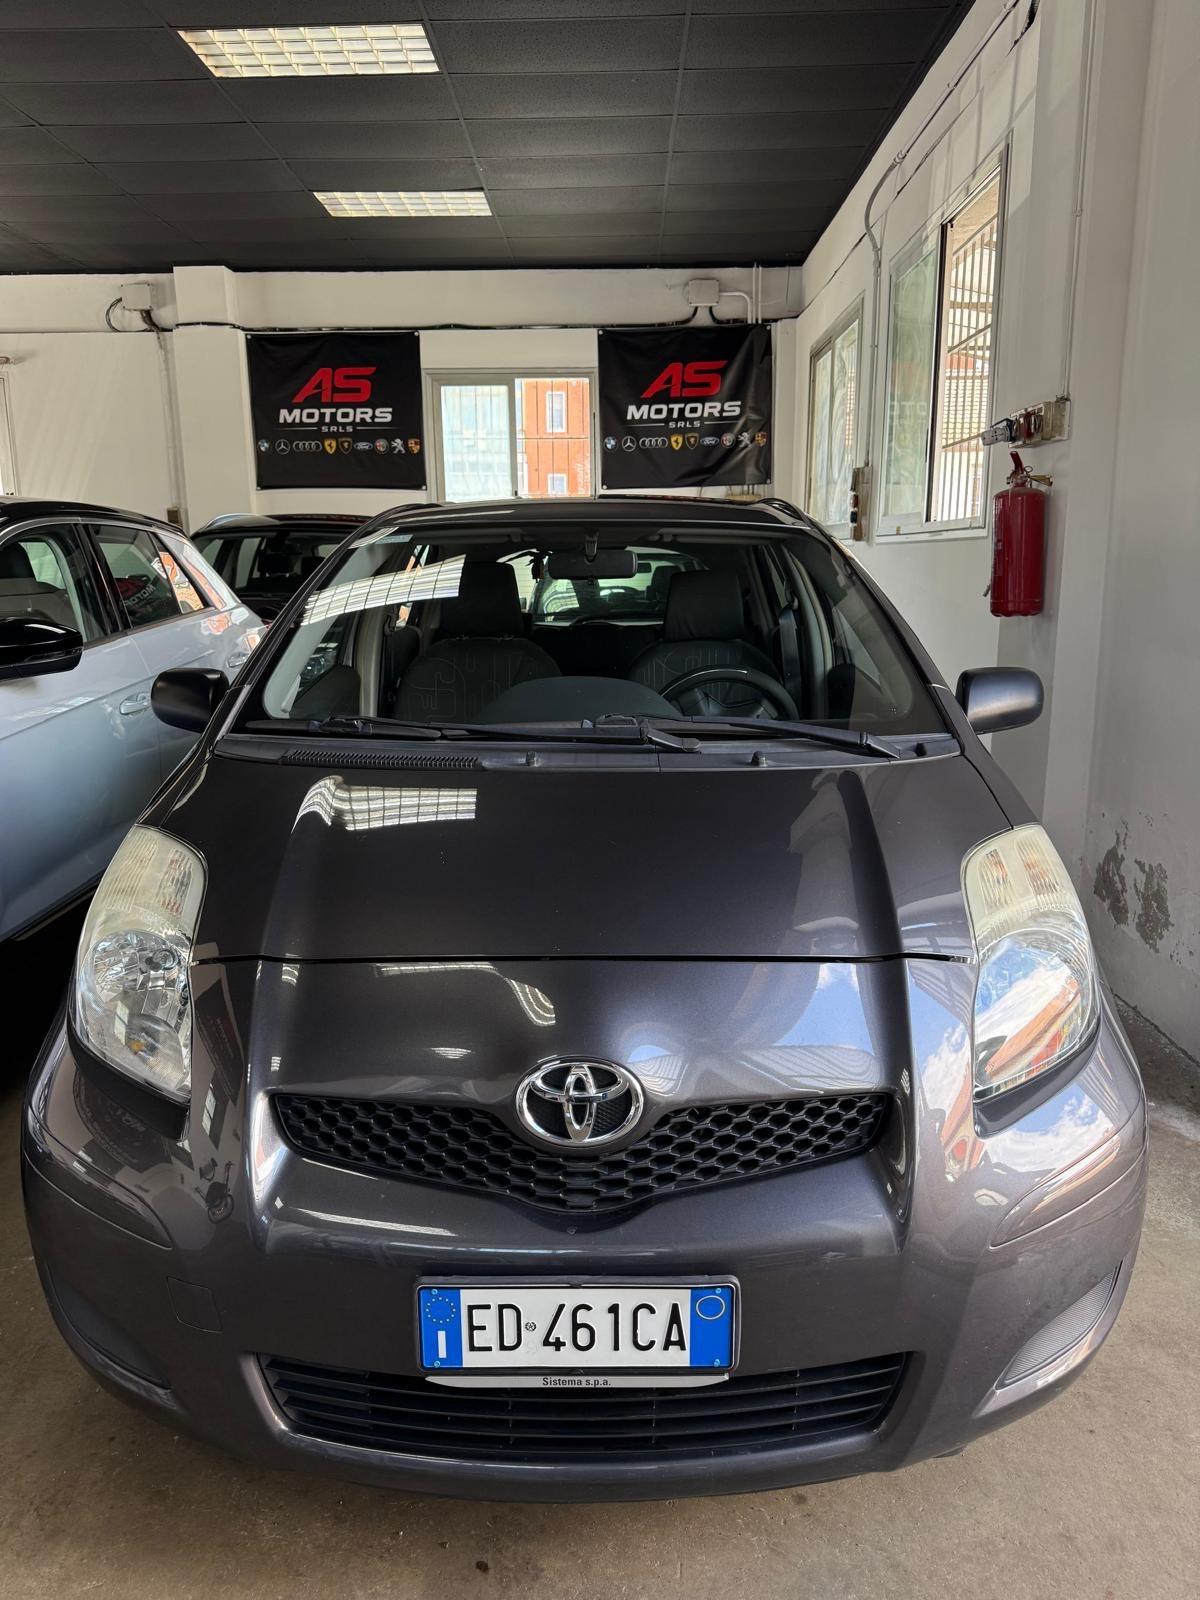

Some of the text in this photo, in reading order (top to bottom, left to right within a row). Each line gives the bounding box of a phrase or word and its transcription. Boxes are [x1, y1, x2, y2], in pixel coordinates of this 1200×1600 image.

[291, 367, 377, 403] AS
[640, 360, 728, 399] AS
[278, 407, 393, 423] MOTORS
[626, 401, 742, 420] MOTORS
[321, 425, 354, 433] SRLS
[668, 420, 701, 428] SRLS
[467, 1302, 687, 1352] ED 461CA
[542, 1376, 611, 1388] Sistema s.p.a.
